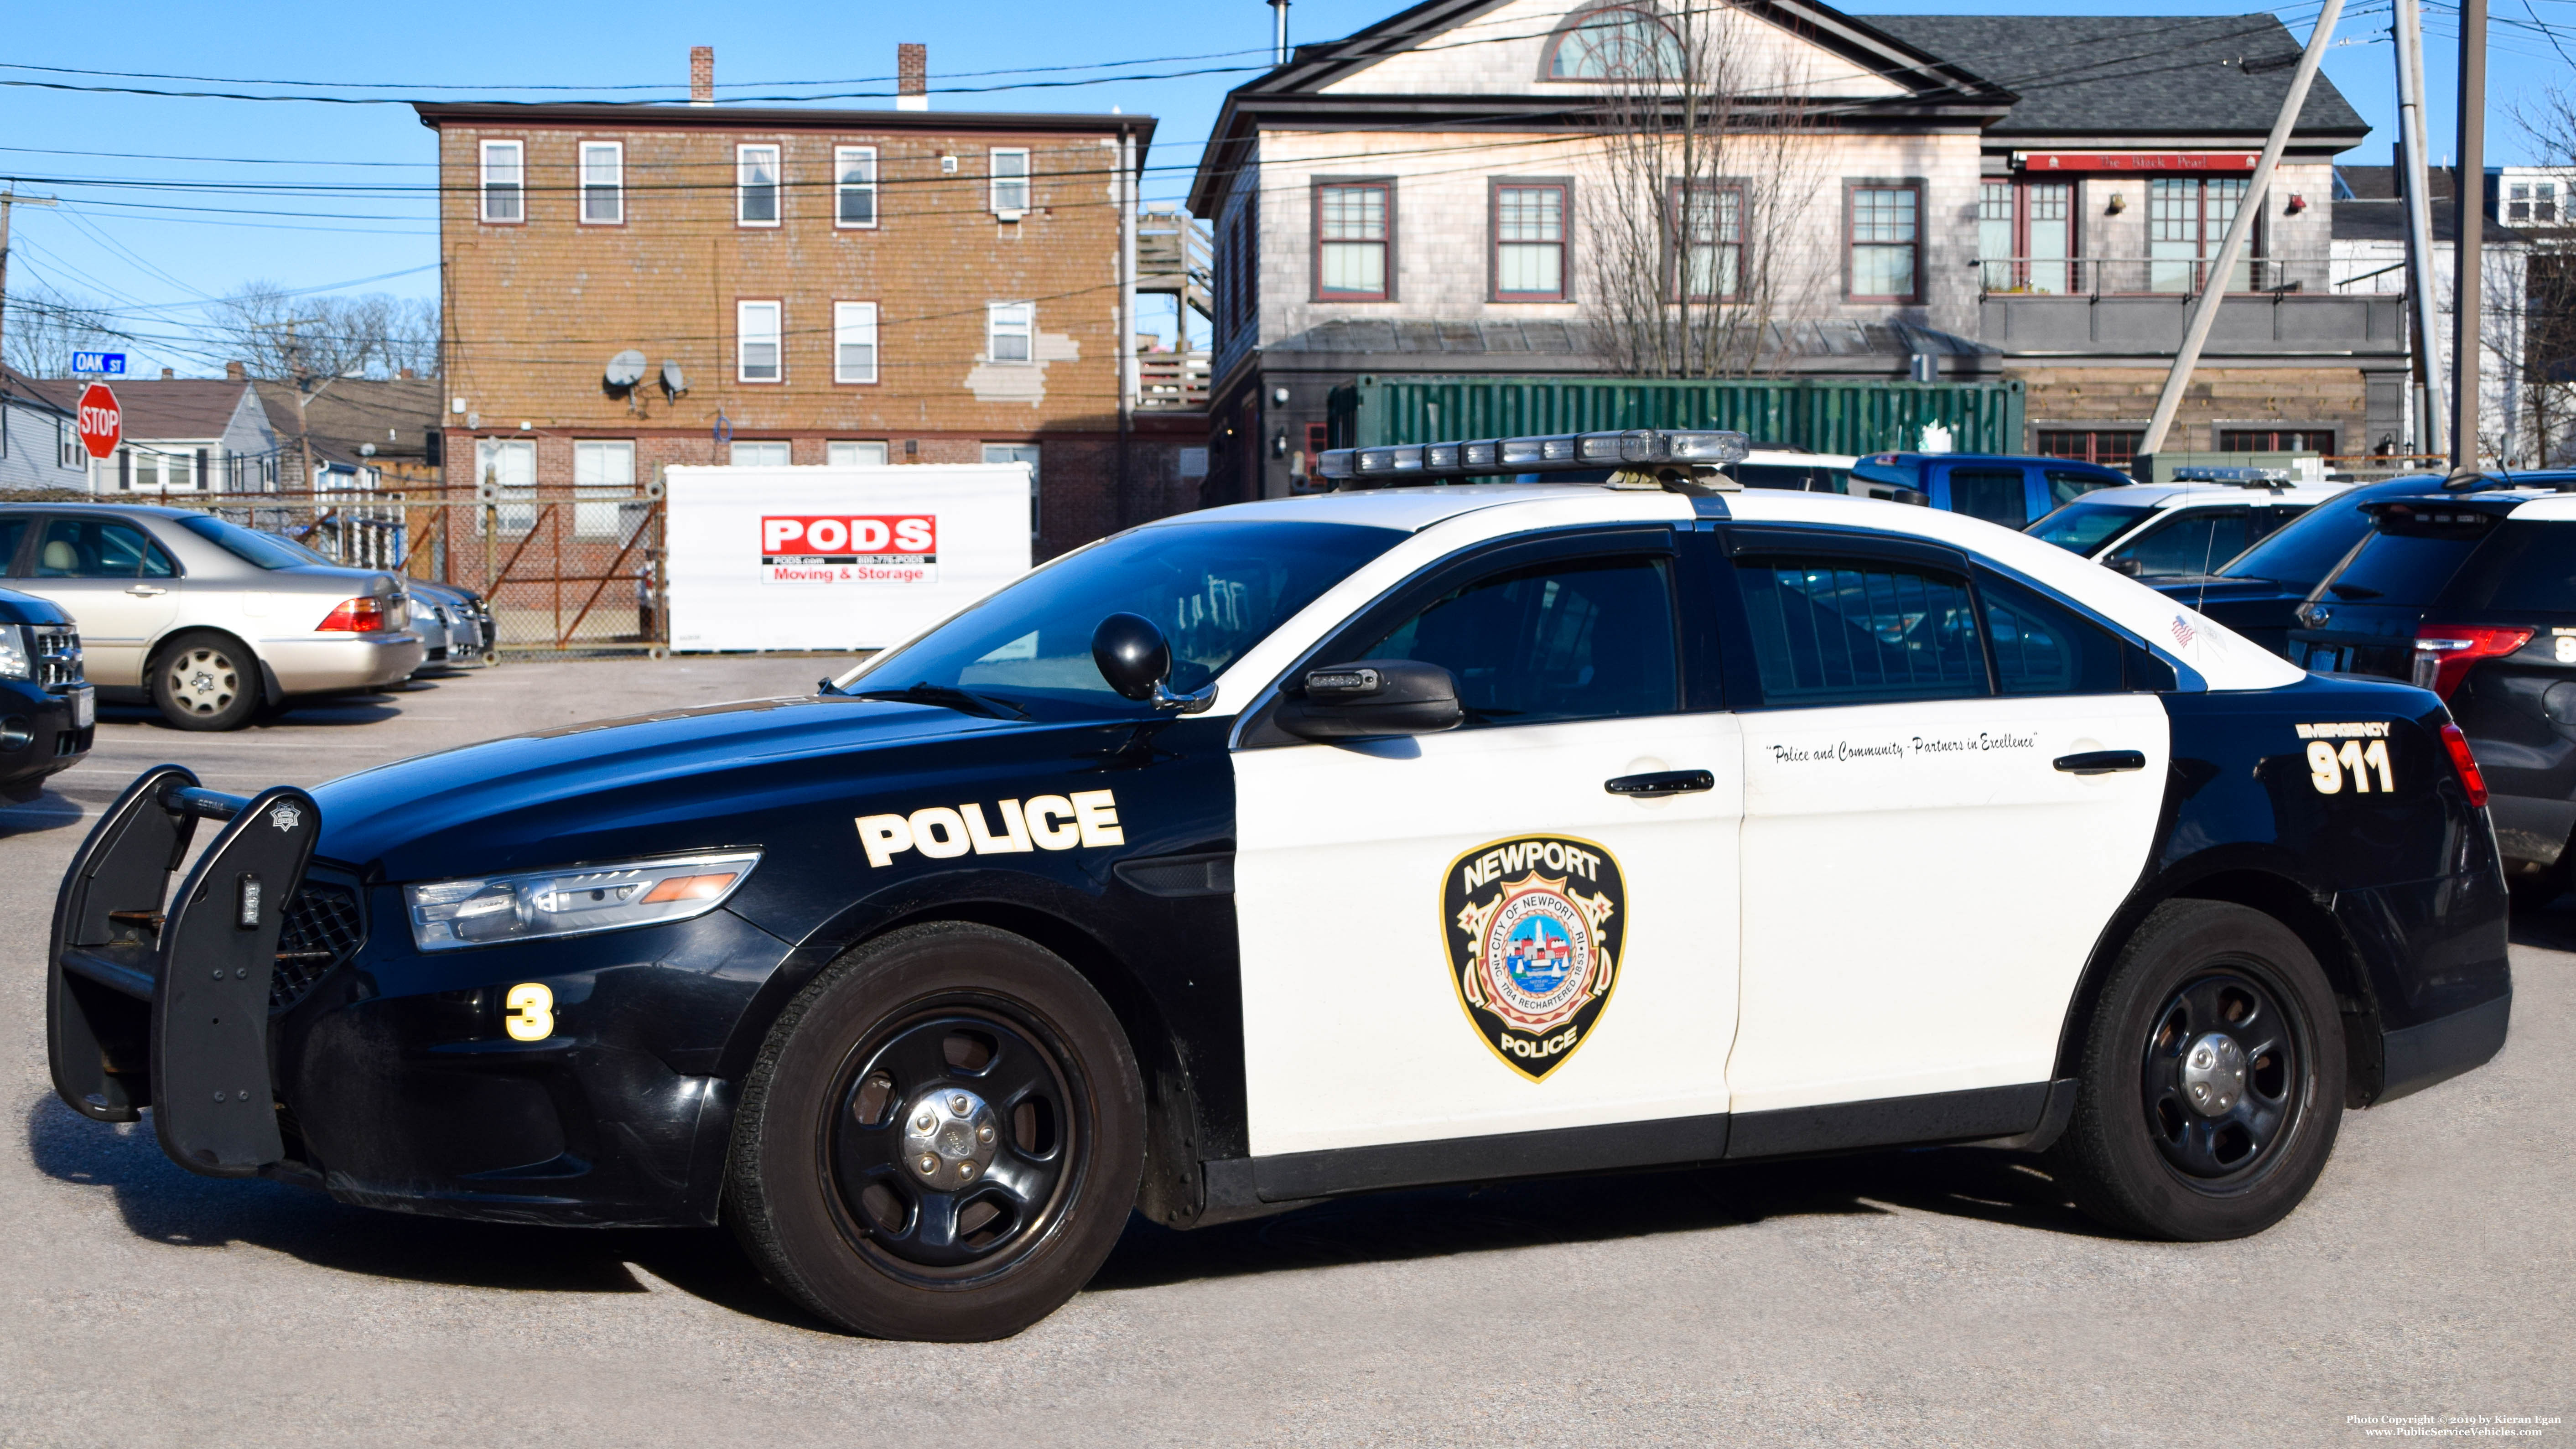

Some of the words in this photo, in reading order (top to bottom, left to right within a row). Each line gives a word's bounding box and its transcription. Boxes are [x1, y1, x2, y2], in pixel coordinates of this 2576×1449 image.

[2100, 156, 2120, 167] The
[2132, 156, 2166, 167] Black
[2178, 156, 2207, 167] Pearl
[77, 353, 104, 371] OAK
[109, 359, 122, 372] ST
[81, 405, 119, 437] STOP
[764, 519, 933, 551] PODS
[773, 556, 825, 564] PODS.com
[775, 567, 833, 583] Moving
[840, 566, 851, 579] &
[858, 567, 923, 583] Storage
[2295, 722, 2390, 738] EMERGENCY
[1813, 744, 1835, 760] and
[1839, 741, 1904, 761] Community
[1912, 737, 1963, 755] Partners
[1967, 737, 1978, 749] in
[2307, 740, 2394, 794] 911
[855, 789, 1125, 868] POLICE
[1464, 841, 1600, 895] NEWPORT
[1492, 920, 1506, 950] CITY
[1506, 903, 1519, 919] OF
[1575, 931, 1585, 944] RI
[1501, 982, 1517, 1001] 1784
[1518, 979, 1576, 1009] RECHARTERED
[1574, 953, 1584, 976] 1853
[506, 983, 554, 1041] 3
[1501, 1025, 1577, 1058] POLICE
